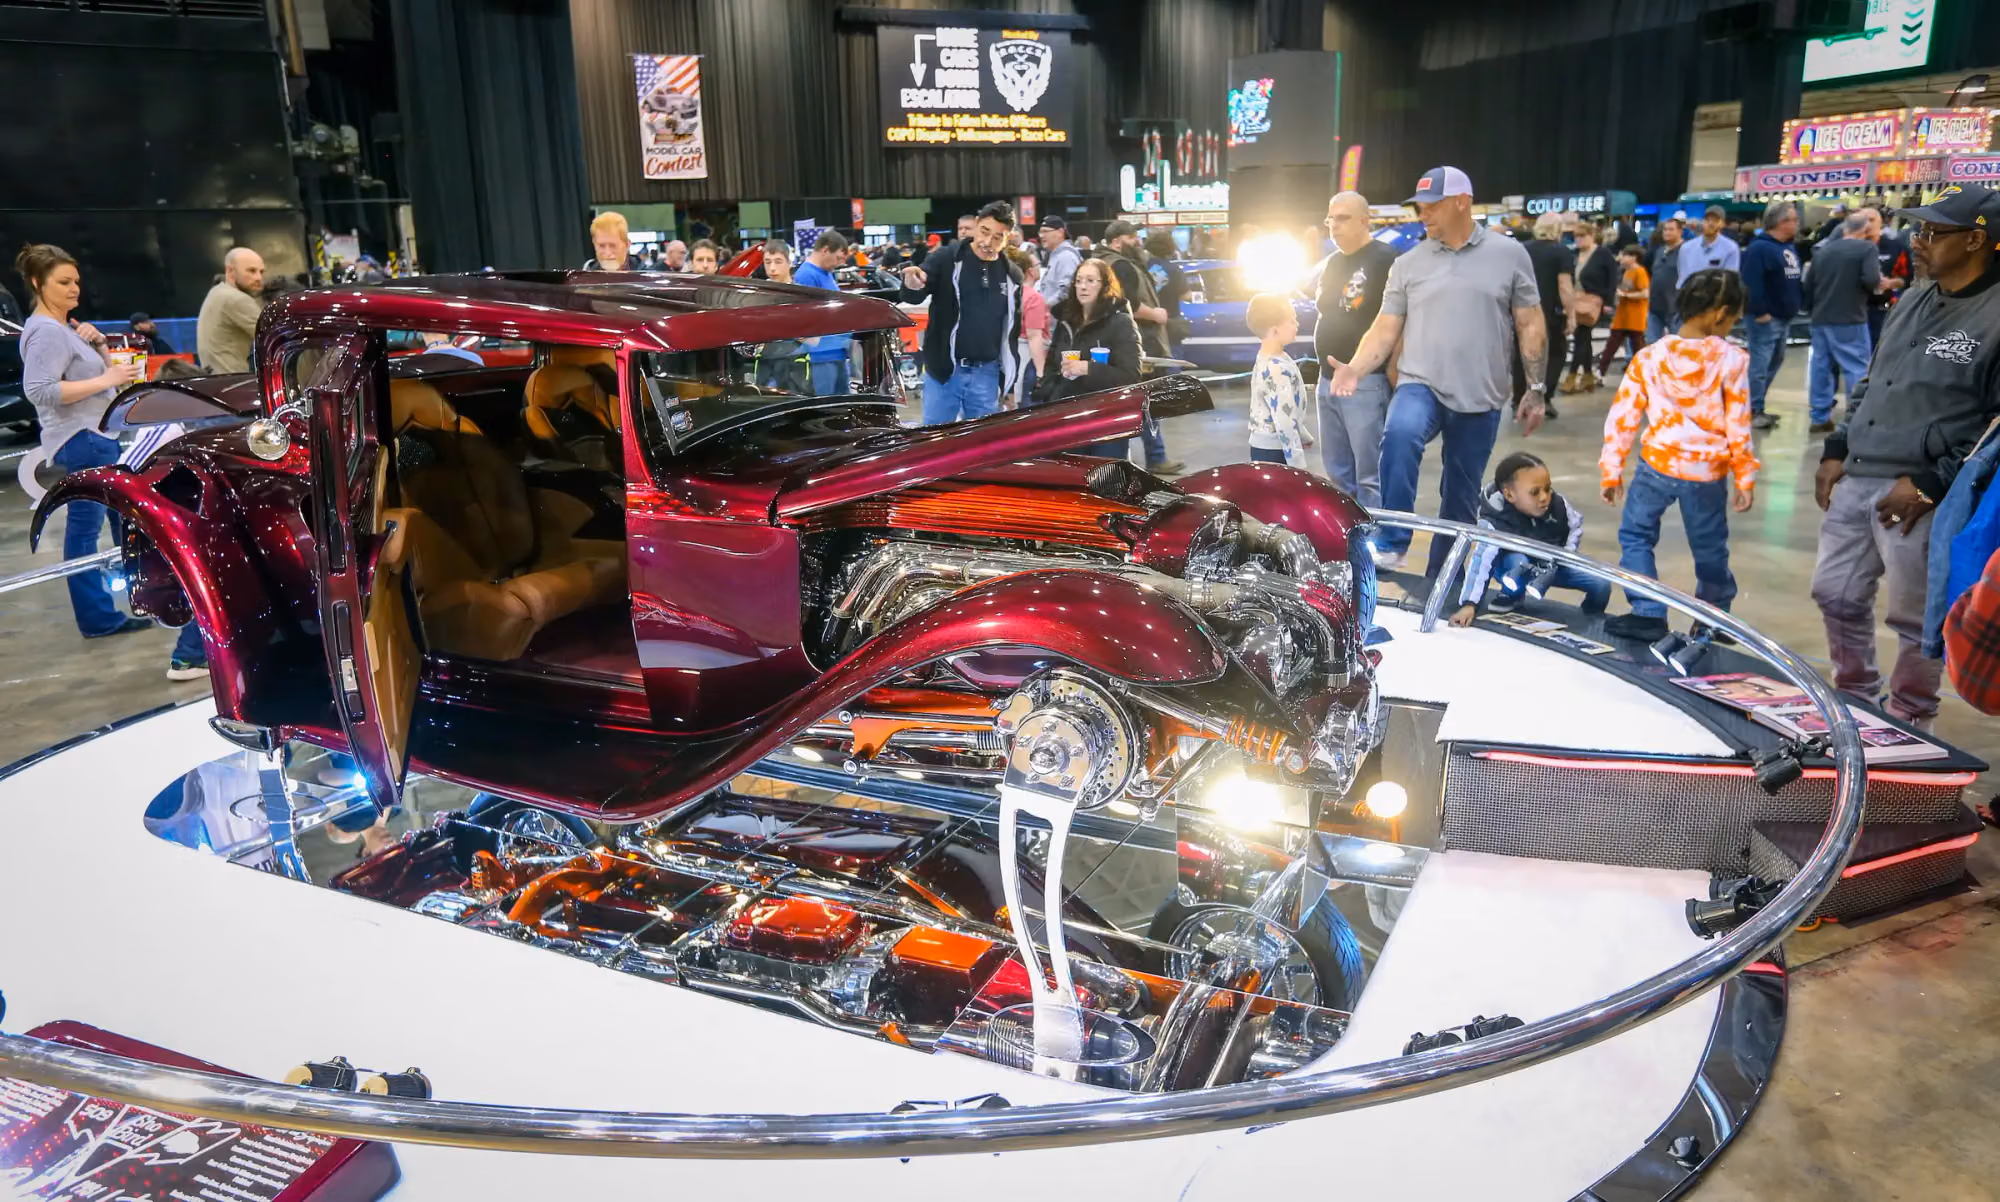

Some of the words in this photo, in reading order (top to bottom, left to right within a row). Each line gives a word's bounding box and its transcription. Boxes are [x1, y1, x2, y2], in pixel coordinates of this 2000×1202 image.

[981, 113, 1009, 128] Police
[1009, 113, 1047, 128] Officers
[1044, 128, 1066, 142] Cars
[1814, 125, 1841, 152] ICE
[1842, 118, 1893, 150] CREAM
[1928, 117, 1946, 144] ICE
[1947, 116, 1982, 144] CREAM
[646, 147, 678, 155] MODEL
[646, 153, 703, 176] Contest
[1916, 160, 1933, 171] ICE
[1762, 169, 1862, 187] CONES
[1904, 169, 1939, 183] CREAM
[1528, 198, 1563, 214] COLD
[1569, 196, 1605, 211] BEER
